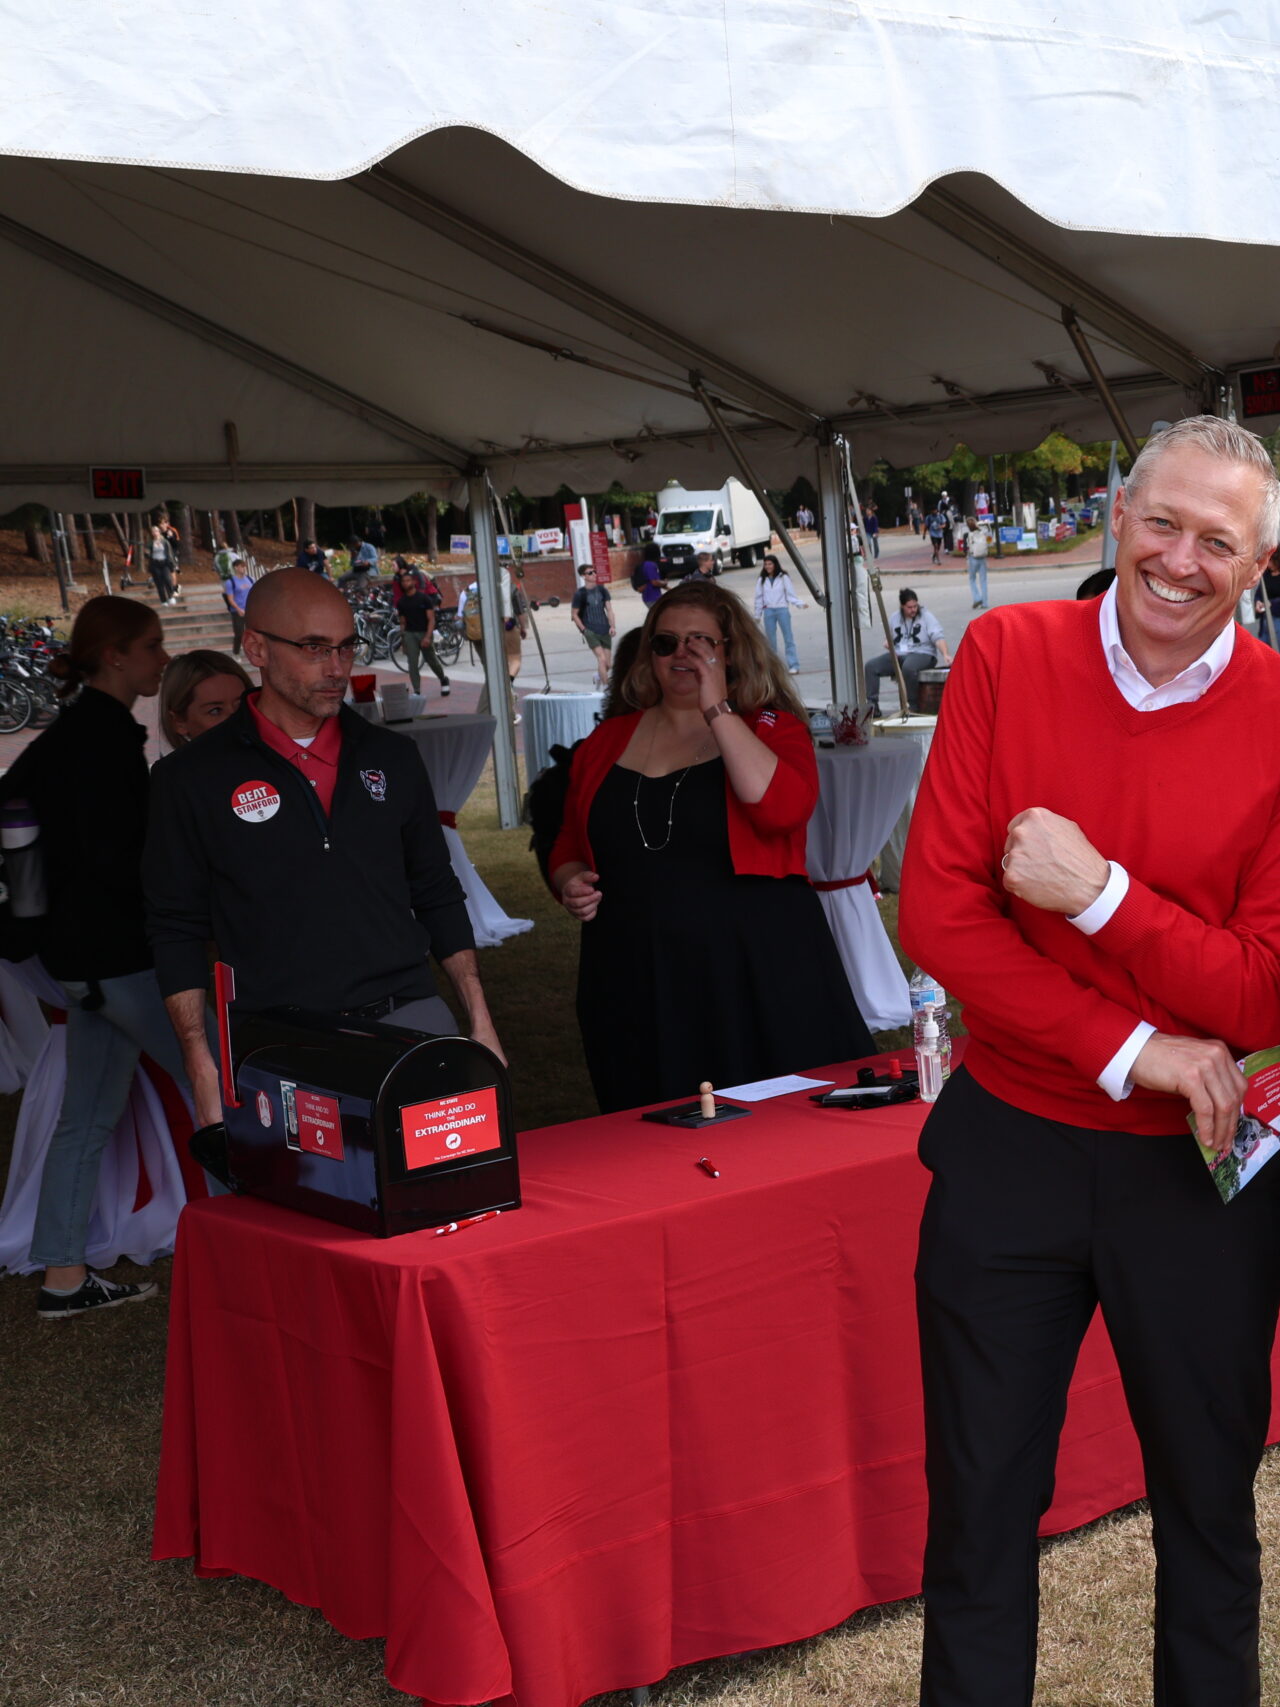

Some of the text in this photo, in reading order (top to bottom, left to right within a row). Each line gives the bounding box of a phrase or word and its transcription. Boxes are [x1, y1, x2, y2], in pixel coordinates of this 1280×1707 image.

[1253, 371, 1280, 393] NO
[95, 471, 141, 497] EXIT
[537, 530, 560, 539] VOTE
[238, 786, 267, 804] BEAT
[236, 796, 279, 815] STANFORD
[424, 1103, 476, 1120] THINK AND DO
[415, 1114, 487, 1137] EXTRAORDINARY
